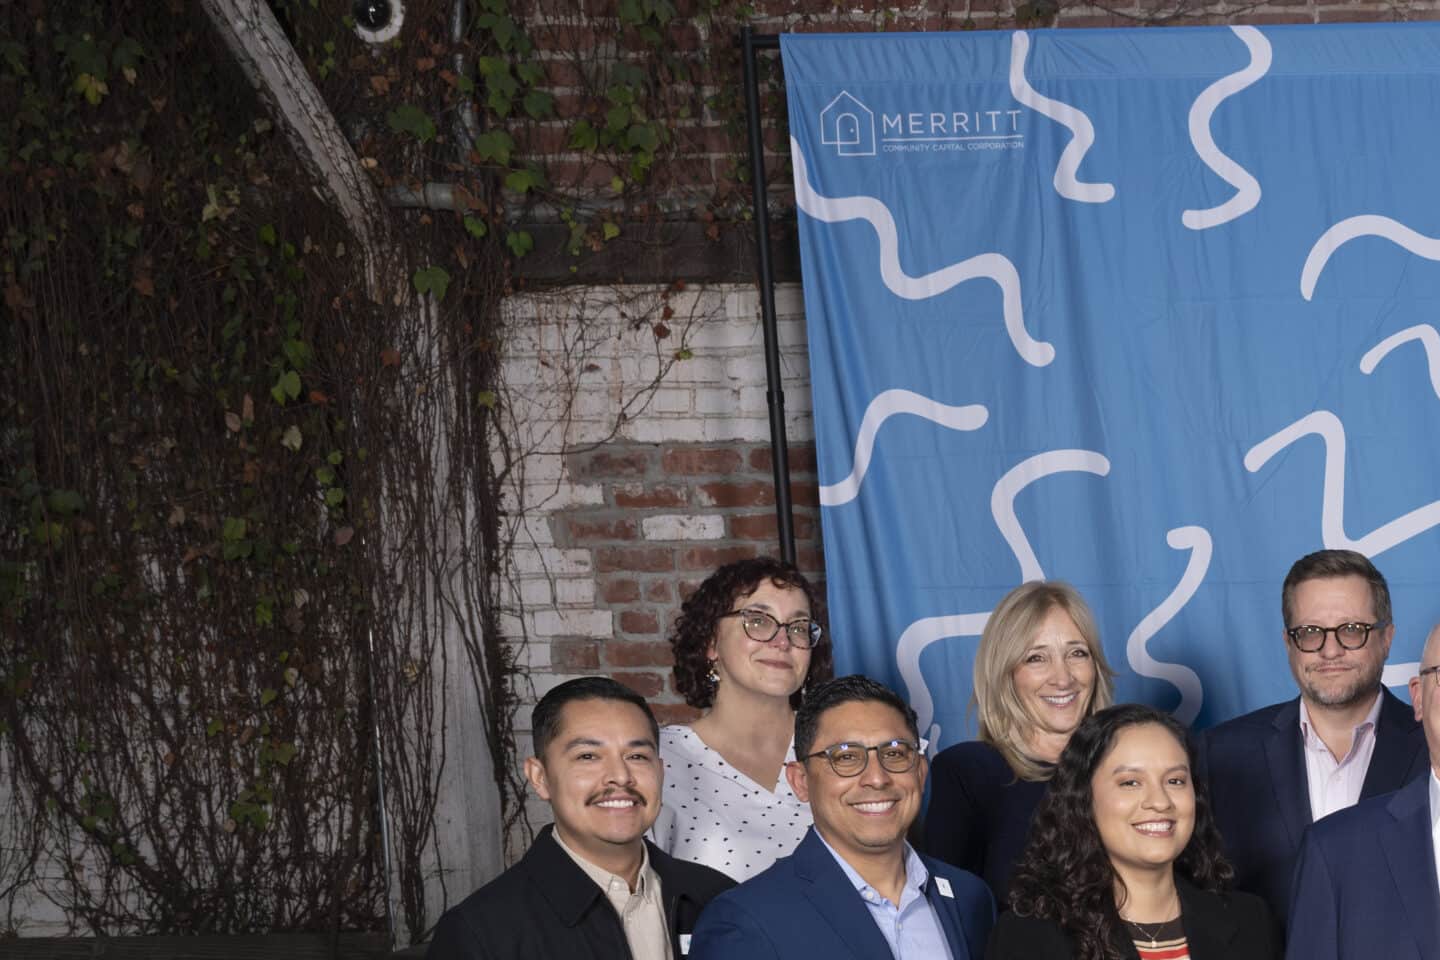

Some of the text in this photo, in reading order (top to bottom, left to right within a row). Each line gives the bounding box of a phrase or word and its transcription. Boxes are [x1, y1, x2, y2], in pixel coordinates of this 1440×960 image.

[882, 110, 1021, 134] MERRITT
[883, 140, 1024, 152] COMMUNITY CAPITAL CORPORATION
